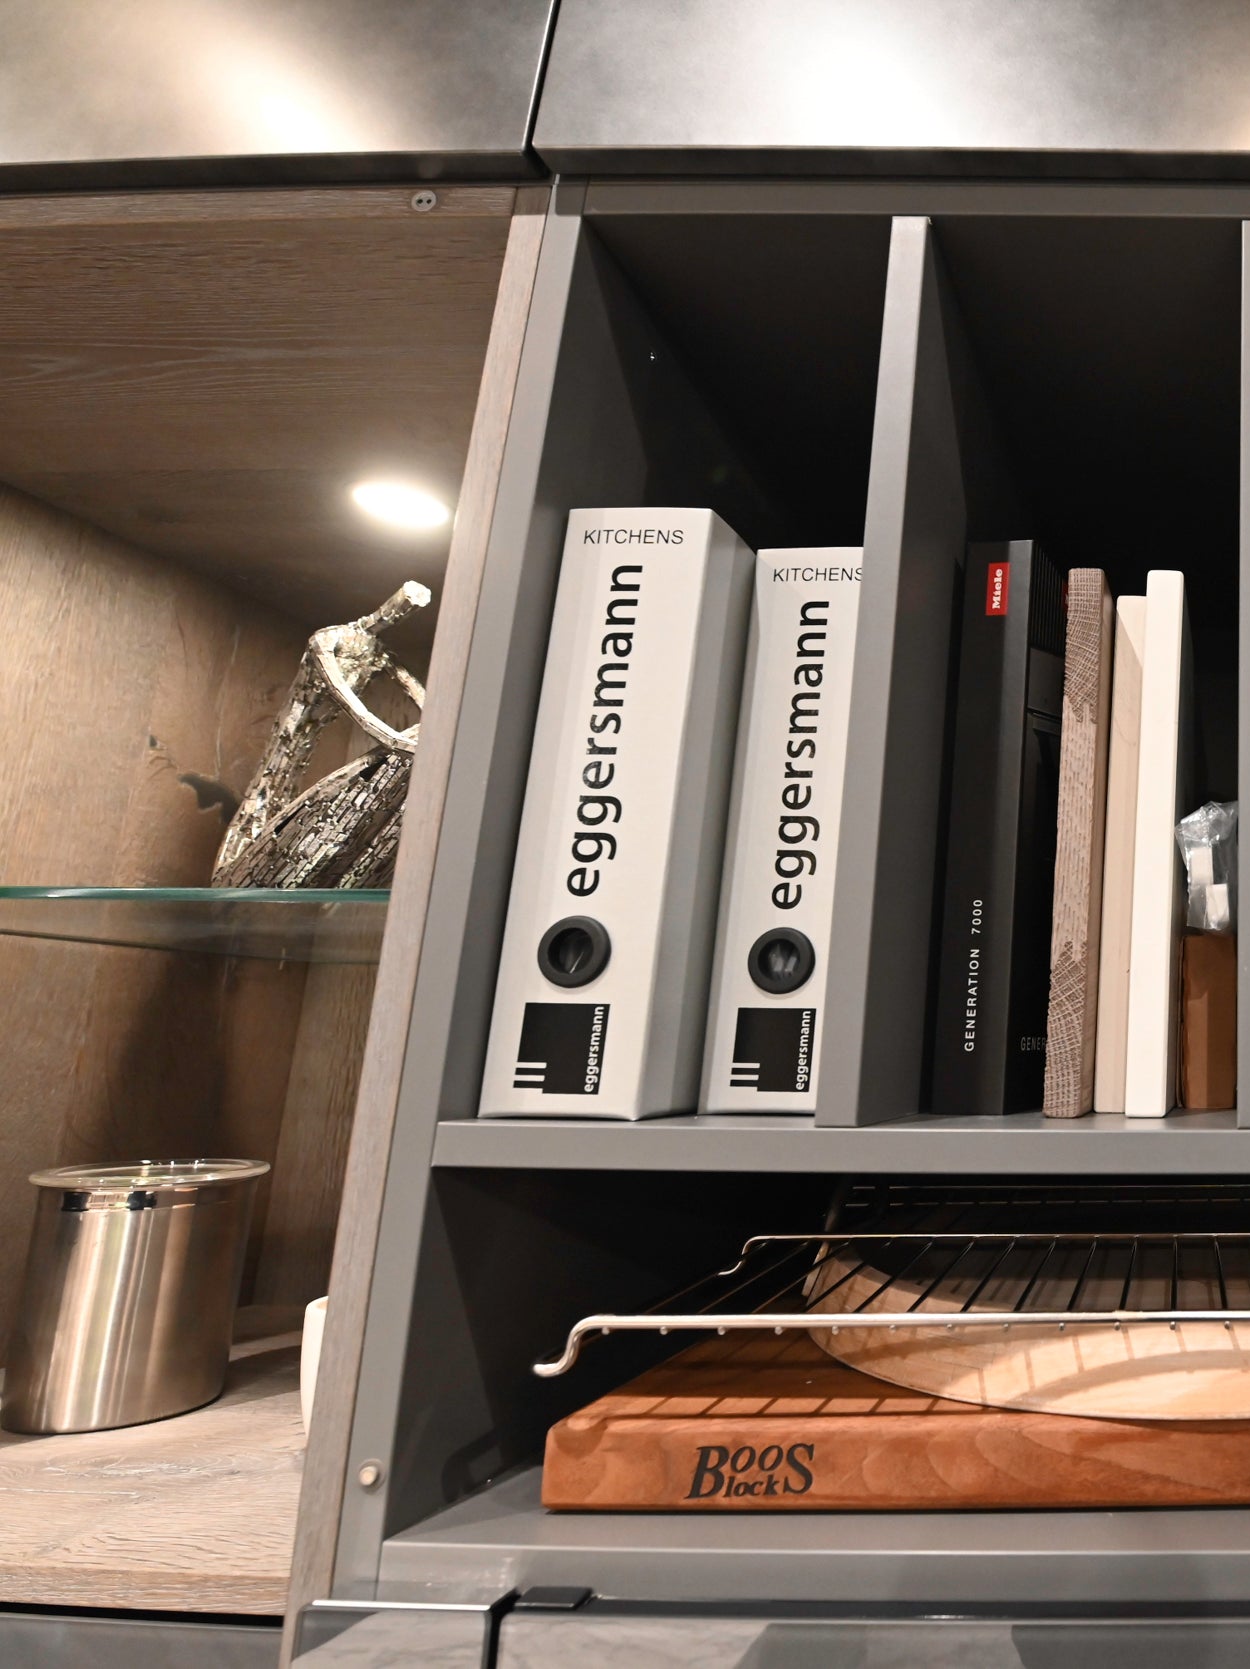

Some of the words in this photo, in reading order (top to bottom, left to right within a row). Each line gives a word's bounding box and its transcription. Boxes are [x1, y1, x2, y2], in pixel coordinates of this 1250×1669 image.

[583, 529, 684, 545] KITCHENS
[773, 567, 863, 582] KITCHENS
[991, 568, 1003, 609] Miele
[566, 564, 644, 897] eggersmann
[771, 600, 830, 910] eggersmann
[971, 898, 983, 935] 7000
[963, 948, 981, 1053] GENERATION
[584, 1006, 605, 1093] eggersmann
[795, 1010, 812, 1091] eggersmann
